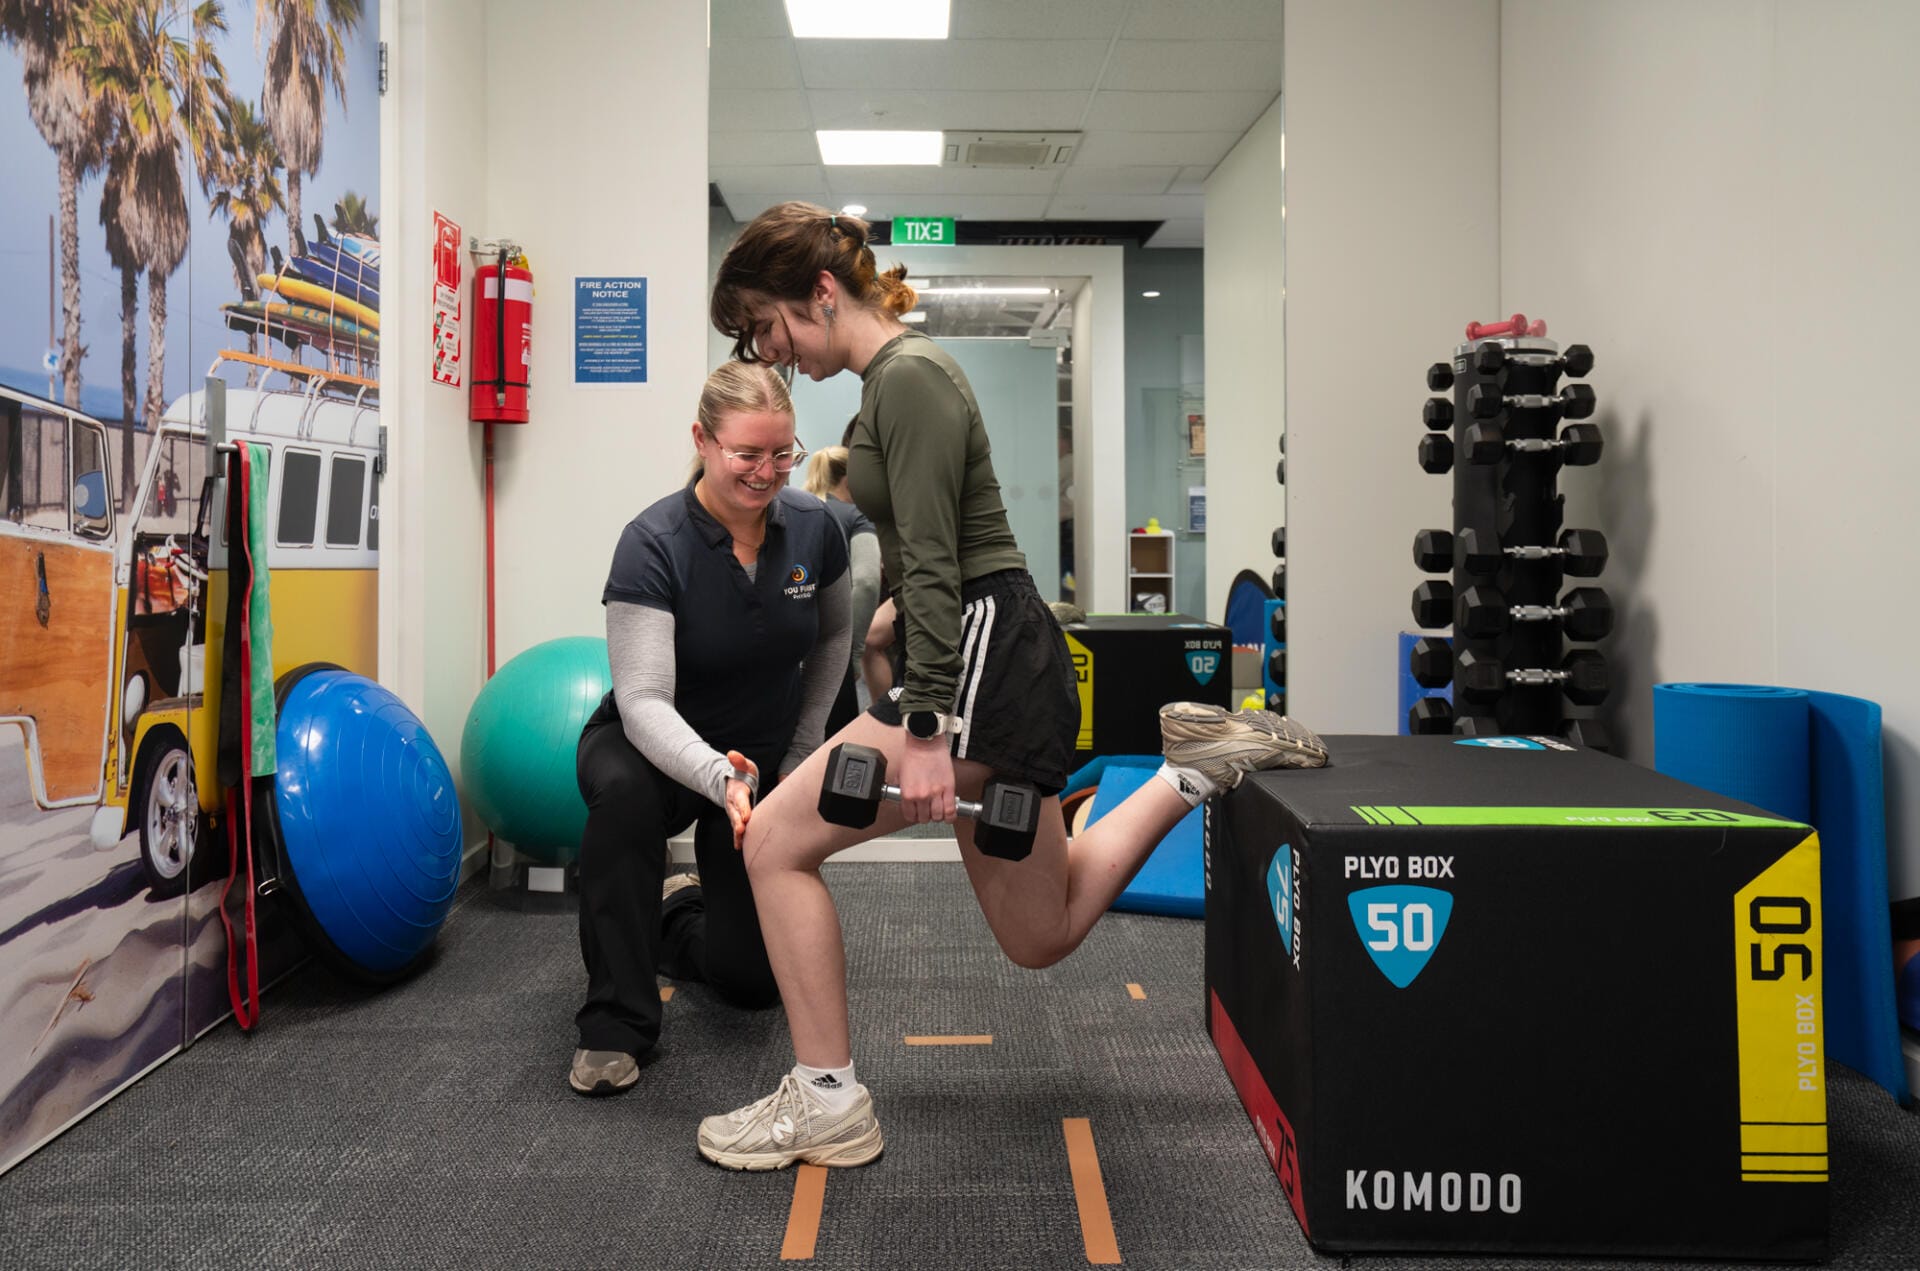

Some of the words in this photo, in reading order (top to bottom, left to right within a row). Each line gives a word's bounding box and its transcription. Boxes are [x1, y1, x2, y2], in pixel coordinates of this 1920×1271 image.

[580, 281, 602, 289] FIRE
[604, 281, 642, 289] ACTION
[592, 290, 629, 298] NOTICE
[1648, 810, 1740, 822] 60
[1292, 848, 1301, 911] PLYO
[1344, 856, 1399, 879] PLYO
[1408, 856, 1455, 879] BOX
[1276, 859, 1290, 933] 75
[1292, 916, 1301, 972] BOX
[1367, 903, 1434, 951] 50
[1750, 896, 1812, 981] 50
[1795, 993, 1816, 1035] BOX
[1797, 1042, 1818, 1091] PLYO
[1275, 1117, 1295, 1198] 75
[1346, 1169, 1522, 1214] KOMODO
